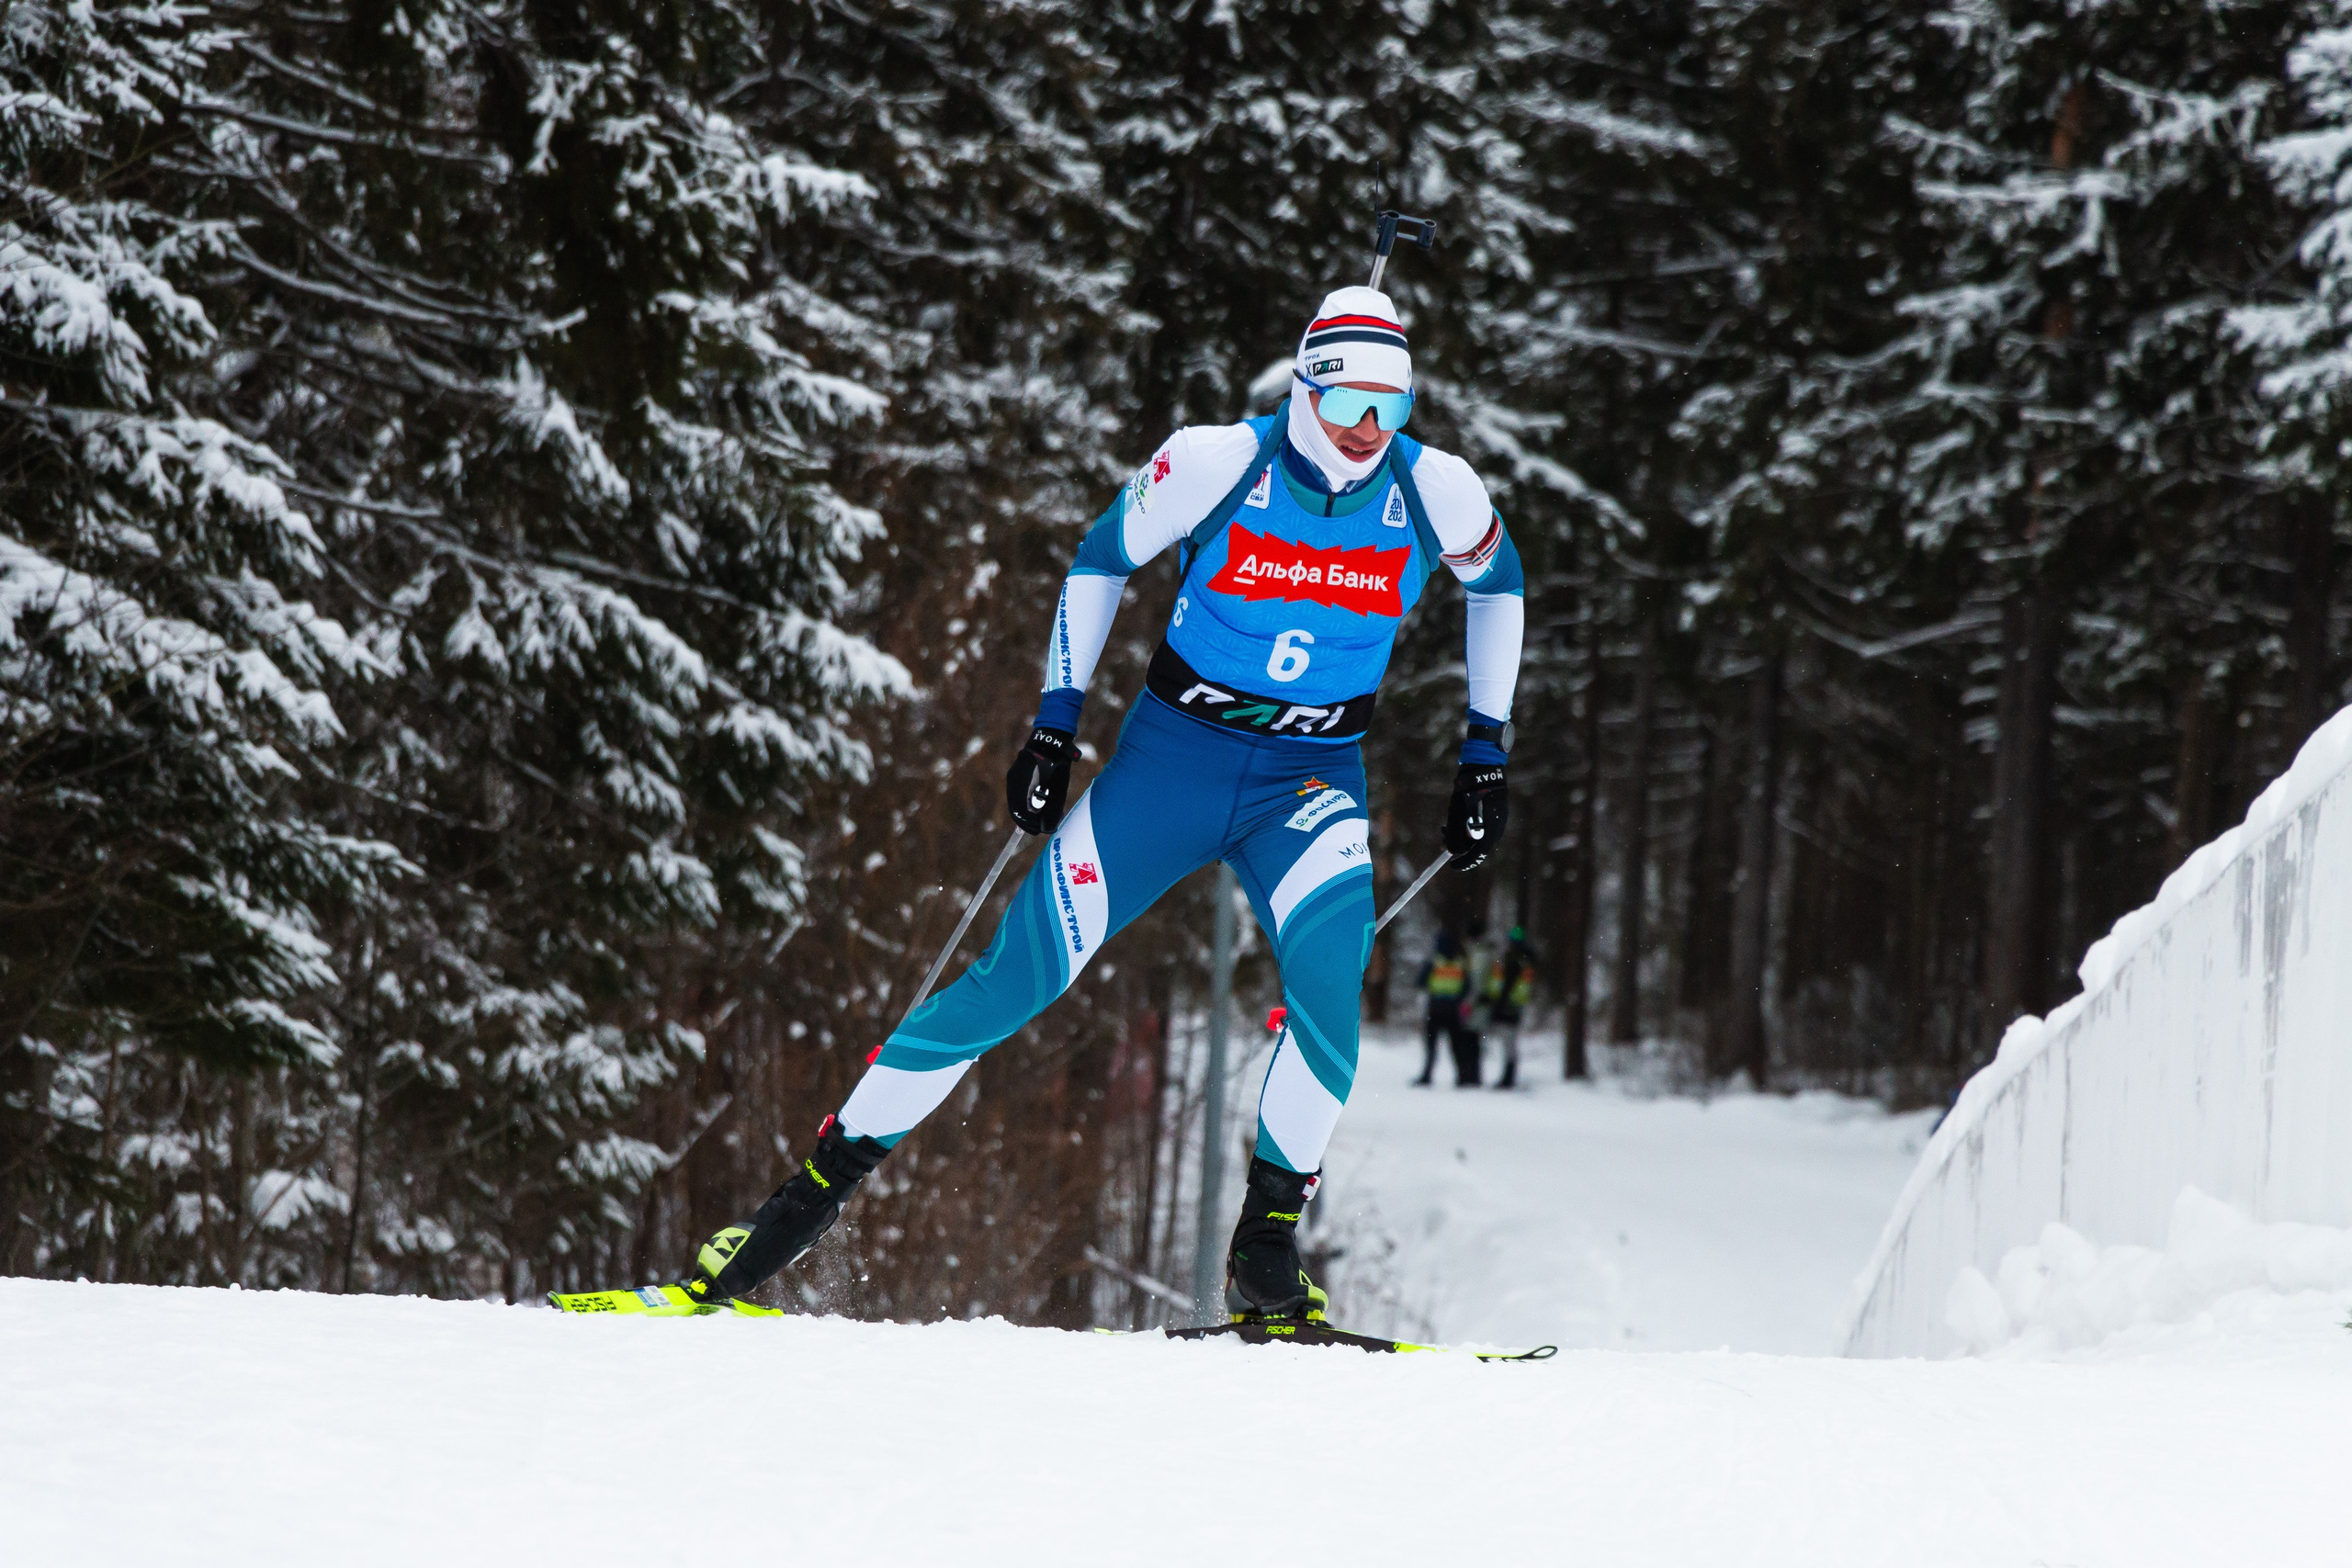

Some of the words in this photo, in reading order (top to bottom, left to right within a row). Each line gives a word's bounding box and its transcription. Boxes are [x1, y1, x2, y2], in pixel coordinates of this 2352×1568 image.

[1315, 360, 1341, 374] PARI
[1233, 554, 1322, 587] Альфа
[1327, 564, 1389, 592] Банк
[1173, 596, 1189, 627] 6
[1266, 629, 1315, 682] 6
[1179, 682, 1346, 734] PARI
[1034, 733, 1063, 748] MOAX
[1476, 773, 1503, 783] MOAX
[1053, 838, 1084, 953] ПРОМФИНСТРОЙ
[1265, 1325, 1295, 1336] FISCHER
